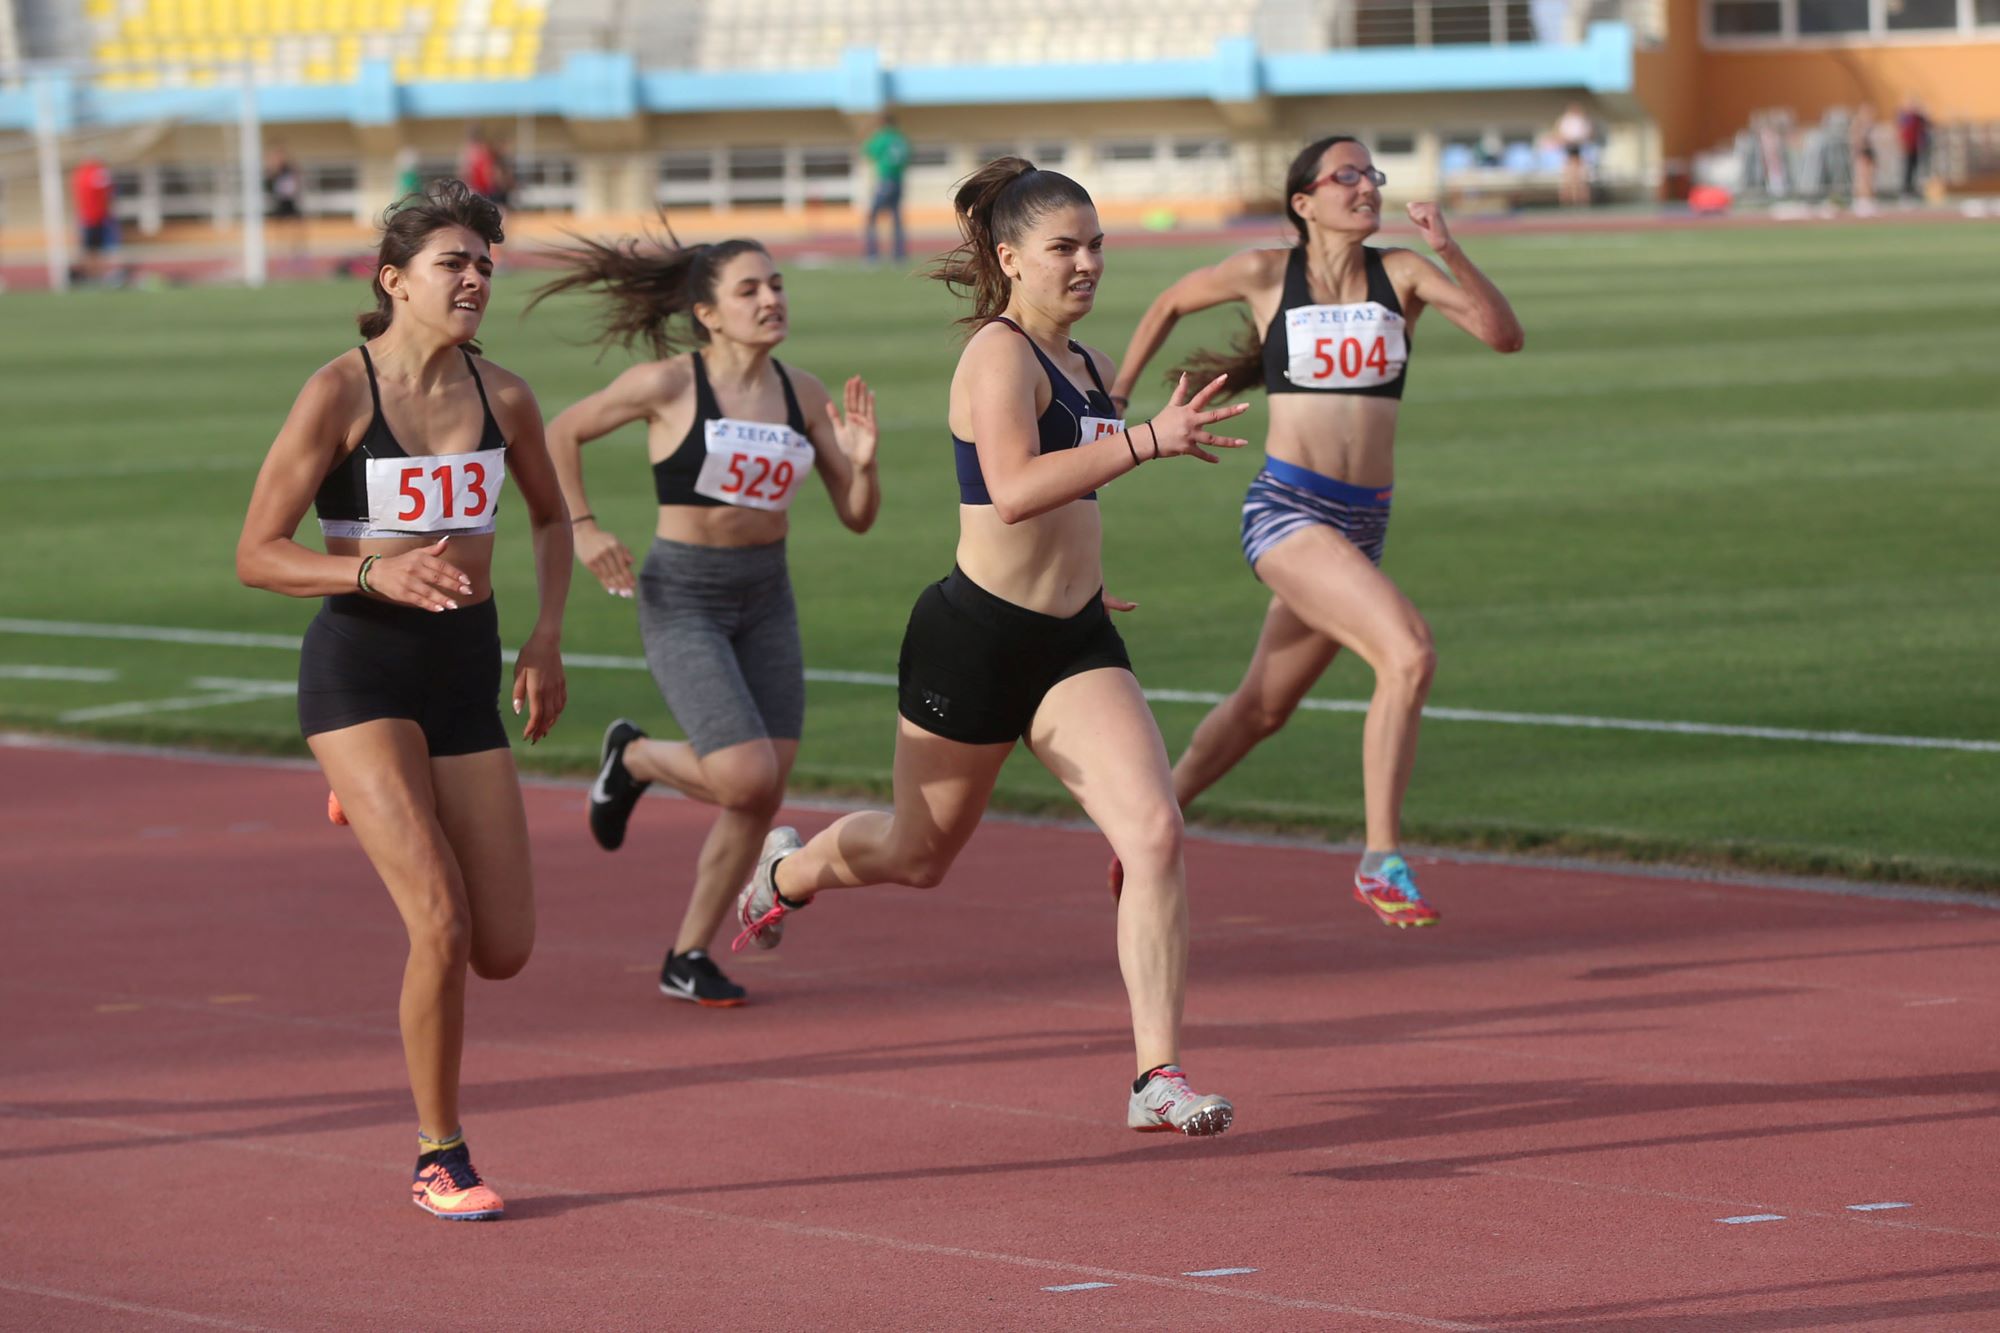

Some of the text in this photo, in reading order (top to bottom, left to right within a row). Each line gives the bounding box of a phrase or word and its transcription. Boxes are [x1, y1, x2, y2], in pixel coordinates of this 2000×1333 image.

[1318, 308, 1378, 324] ΣΕΓΑΣ
[1312, 336, 1389, 380] 504
[736, 425, 791, 445] ΣΕΓΑΣ
[397, 462, 488, 522] 513
[721, 452, 795, 502] 529
